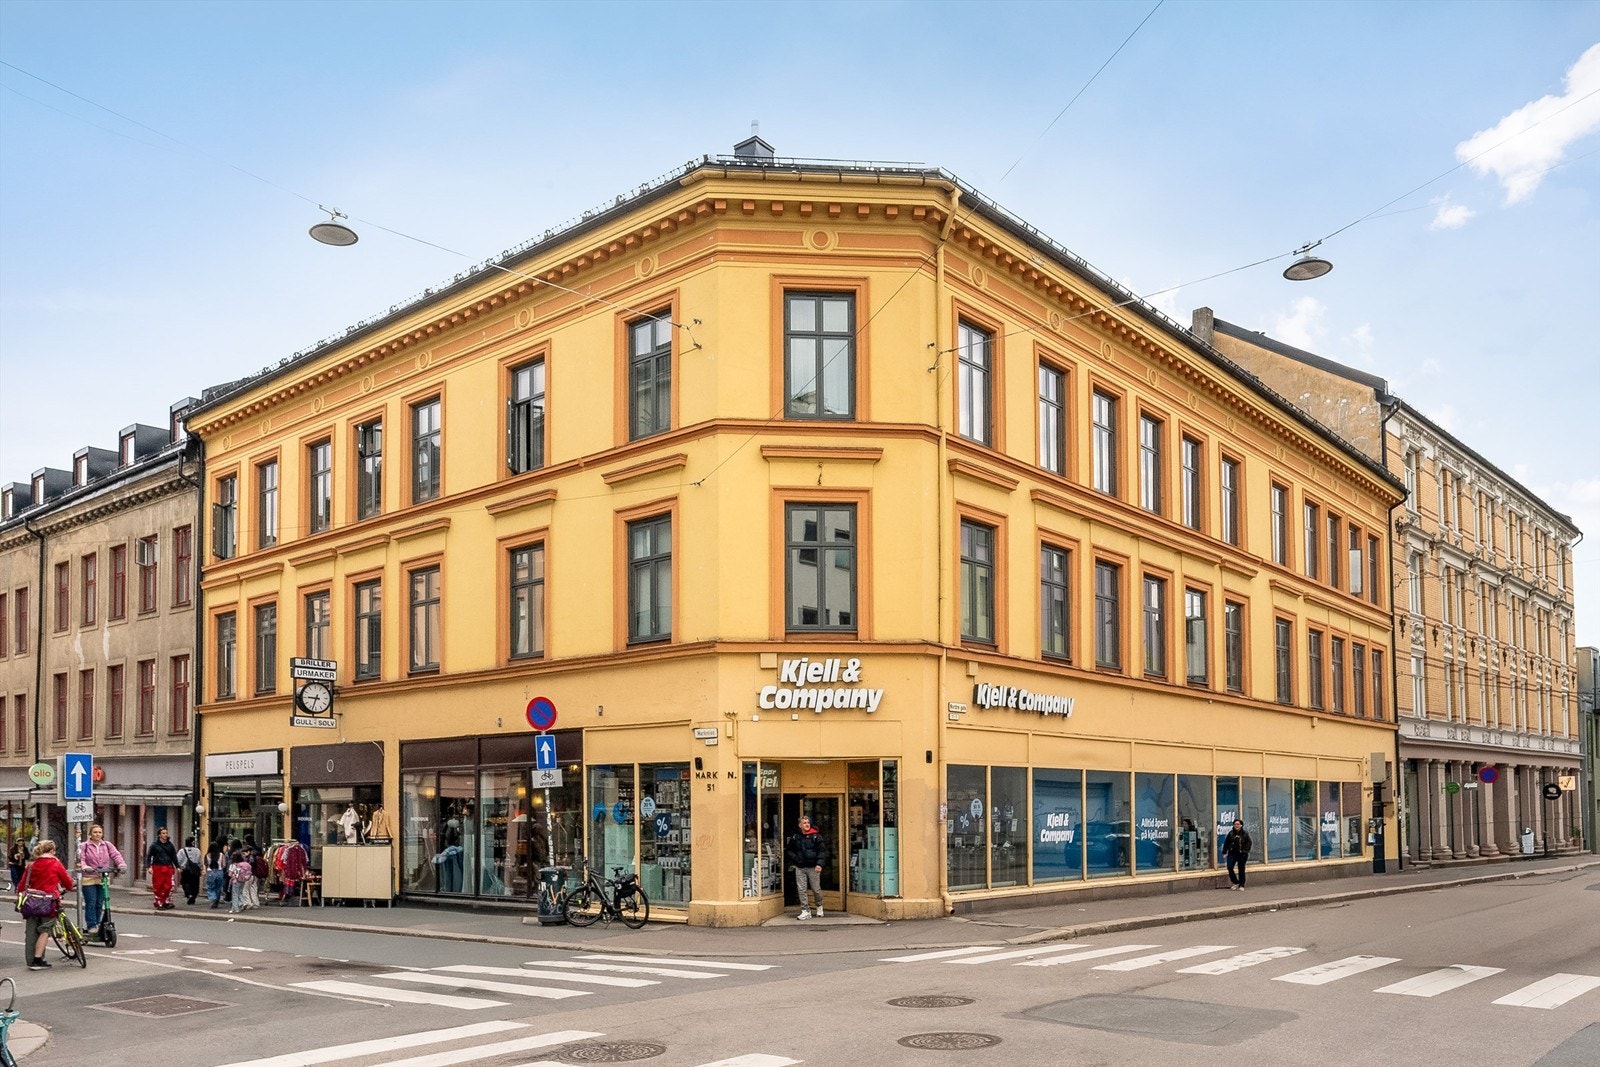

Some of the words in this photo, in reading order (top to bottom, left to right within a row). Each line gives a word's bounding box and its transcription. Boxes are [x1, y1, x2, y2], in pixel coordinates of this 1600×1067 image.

[300, 659, 331, 668] BRILLER
[297, 669, 335, 679] URMAKER
[780, 657, 840, 687] Kjell
[841, 657, 861, 683] &
[759, 684, 884, 713] Company
[976, 682, 1007, 710] Kjell
[1007, 686, 1018, 709] &
[1018, 688, 1074, 718] Company
[225, 759, 255, 770] PELSPELS
[696, 771, 719, 779] MARK
[706, 783, 716, 791] 51
[656, 816, 669, 833] %
[1047, 813, 1062, 829] Kjell
[1062, 813, 1069, 827] &
[1040, 829, 1074, 844] Company
